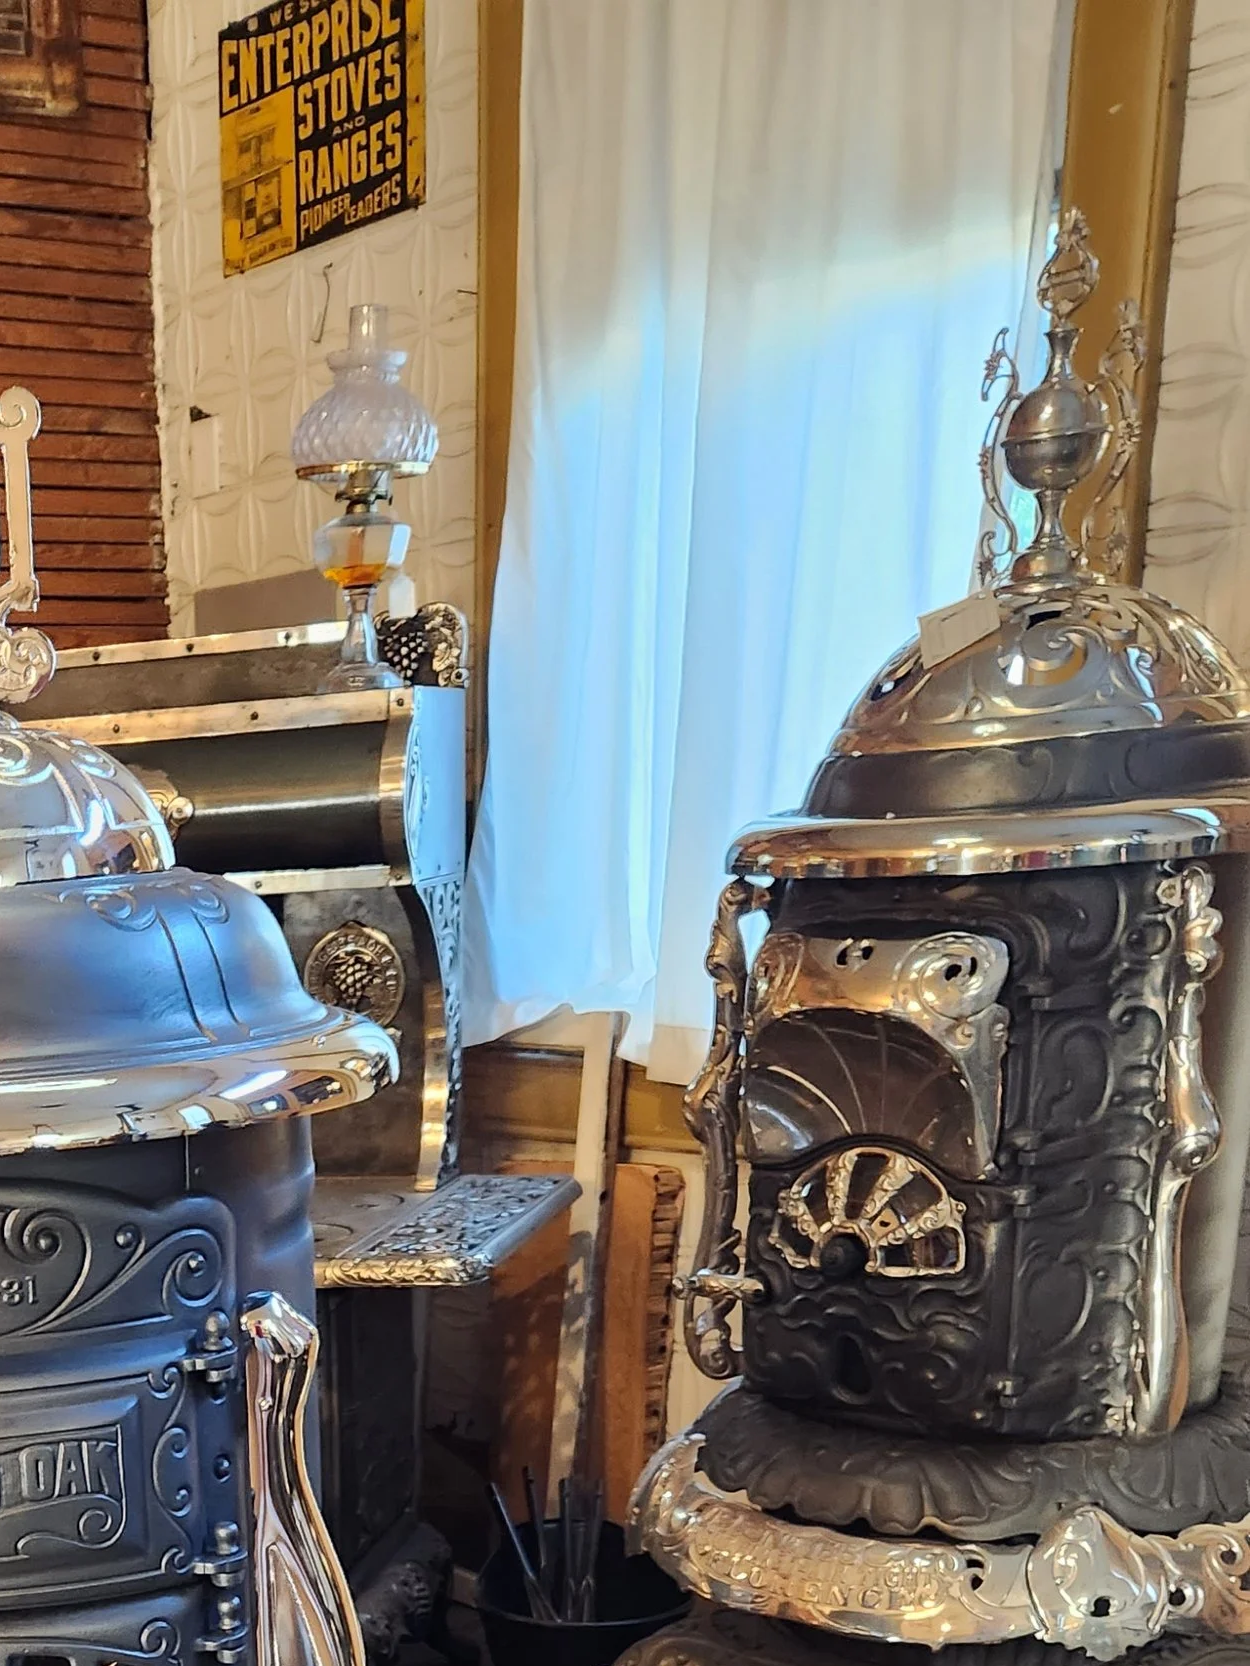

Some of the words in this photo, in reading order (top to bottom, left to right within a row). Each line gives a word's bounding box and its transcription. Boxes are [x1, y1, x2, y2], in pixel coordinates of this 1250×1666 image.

[221, 0, 400, 114] ENTERPRISE
[298, 41, 401, 140] STOVES
[331, 115, 366, 137] AND
[299, 110, 402, 205] RANGES
[300, 193, 351, 241] PIONEER
[344, 173, 402, 225] LEADERS
[20, 1440, 118, 1500] OAK
